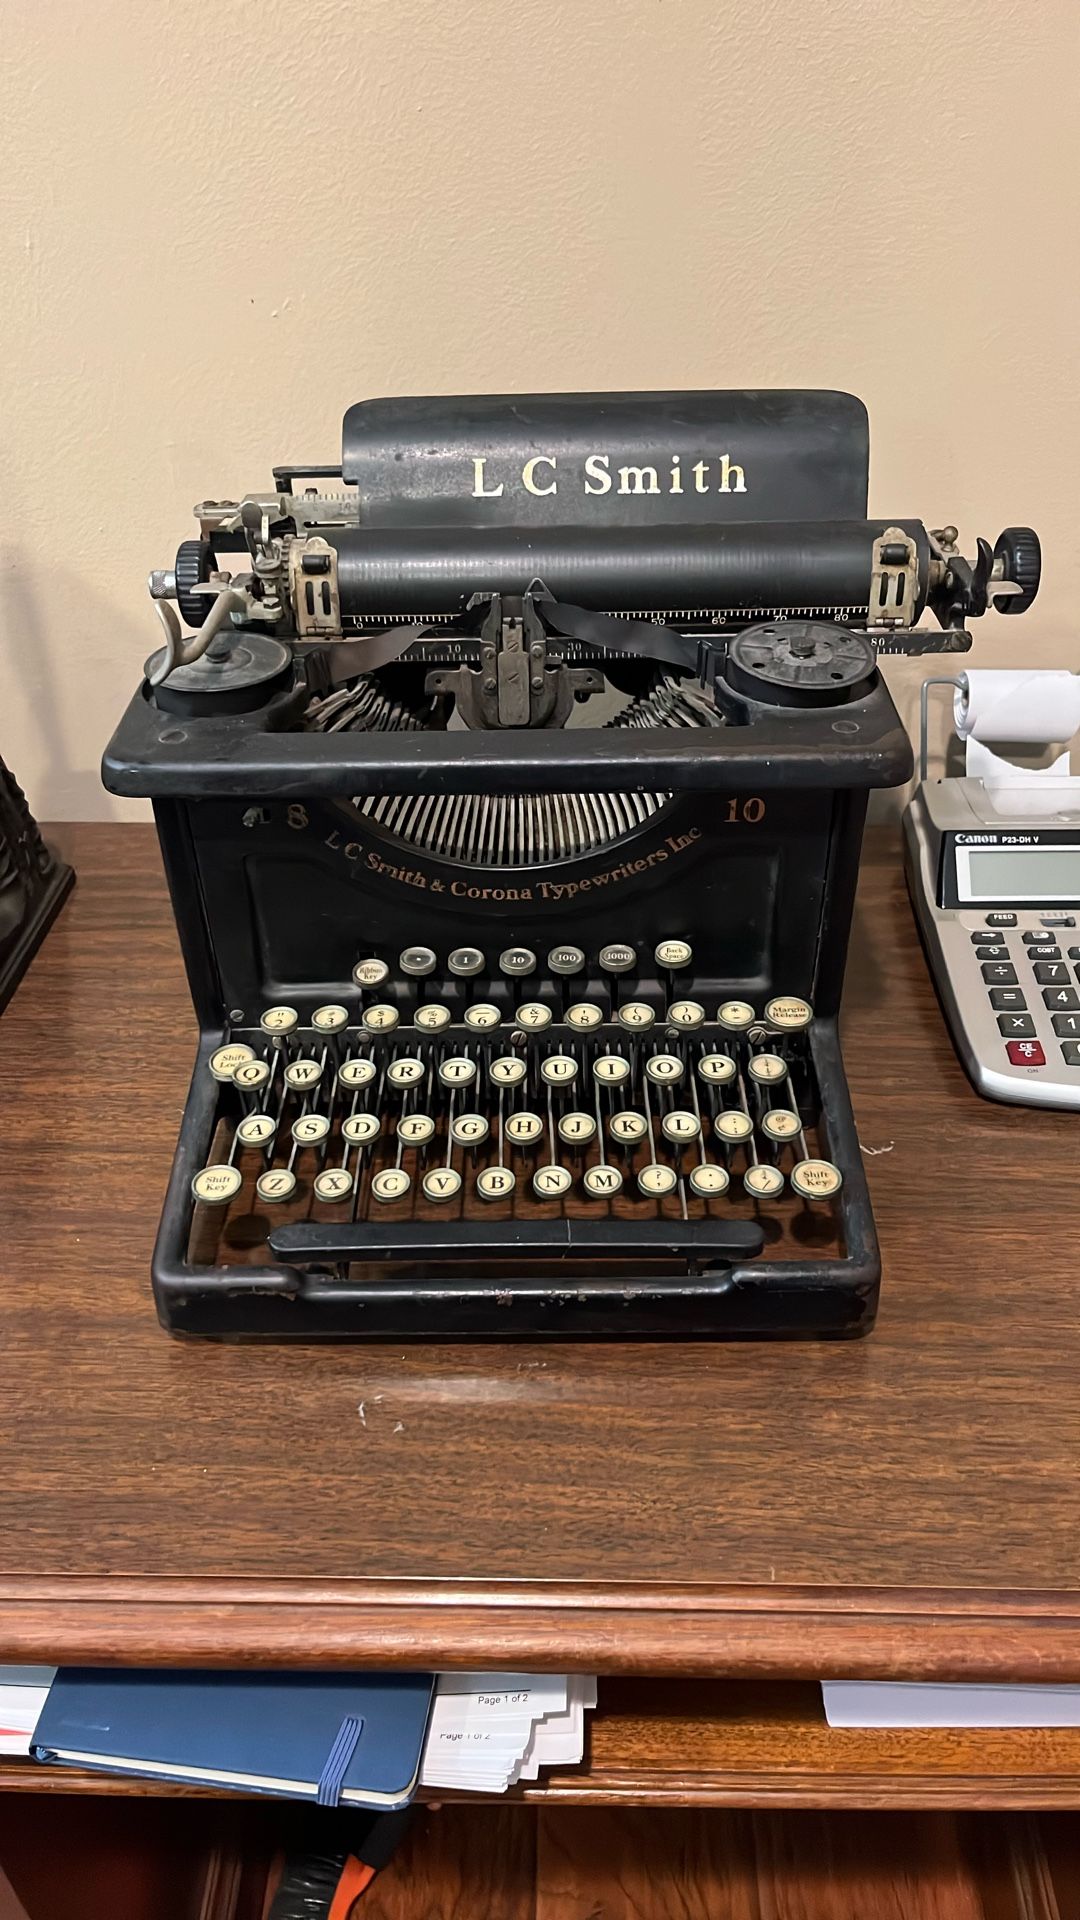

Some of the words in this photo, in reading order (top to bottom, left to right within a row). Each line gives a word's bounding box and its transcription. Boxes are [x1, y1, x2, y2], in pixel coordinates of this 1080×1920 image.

[471, 458, 503, 497] L
[522, 456, 557, 496] C
[584, 455, 748, 495] Smith
[651, 617, 666, 626] 50
[711, 616, 726, 625] 60
[834, 613, 849, 622] 80
[447, 644, 461, 653] 10
[567, 642, 582, 651] 30
[870, 637, 885, 647] 80
[724, 797, 766, 823] 10
[955, 834, 997, 844] Canon
[324, 830, 340, 850] L
[344, 842, 363, 860] C
[366, 852, 427, 889] Smith
[429, 878, 446, 893] &
[450, 880, 533, 901] Corona
[535, 848, 670, 900] Typewriters
[664, 827, 702, 853] Inc
[558, 954, 576, 962] 100
[607, 952, 630, 960] 1000
[1048, 965, 1058, 976] 7
[1057, 991, 1068, 1002] 4
[1067, 1018, 1076, 1029] 1
[222, 1054, 246, 1062] Shift
[352, 1067, 366, 1078] E
[399, 1066, 413, 1077] R
[449, 1066, 466, 1076] T
[502, 1065, 516, 1075] Y
[553, 1064, 568, 1074] U
[608, 1064, 615, 1074] I
[656, 1062, 674, 1073] O
[711, 1062, 725, 1072] P
[243, 1067, 260, 1080] Q
[296, 1068, 314, 1079] W
[248, 1124, 263, 1135] A
[304, 1123, 318, 1134] S
[352, 1121, 371, 1133] D
[410, 1123, 426, 1134] F
[461, 1122, 478, 1134] G
[515, 1121, 533, 1132] H
[571, 1121, 581, 1132] J
[621, 1120, 637, 1132] K
[675, 1119, 690, 1131] L
[545, 1175, 561, 1187] N
[595, 1175, 613, 1187] M
[803, 1171, 828, 1180] Shift
[206, 1183, 227, 1192] Key
[269, 1178, 284, 1190] Z
[325, 1178, 343, 1190] X
[383, 1178, 398, 1190] C
[436, 1178, 451, 1190] V
[491, 1177, 504, 1189] B
[806, 1179, 828, 1187] Key
[478, 1696, 501, 1705] Page
[511, 1693, 521, 1702] of
[522, 1693, 529, 1702] 2
